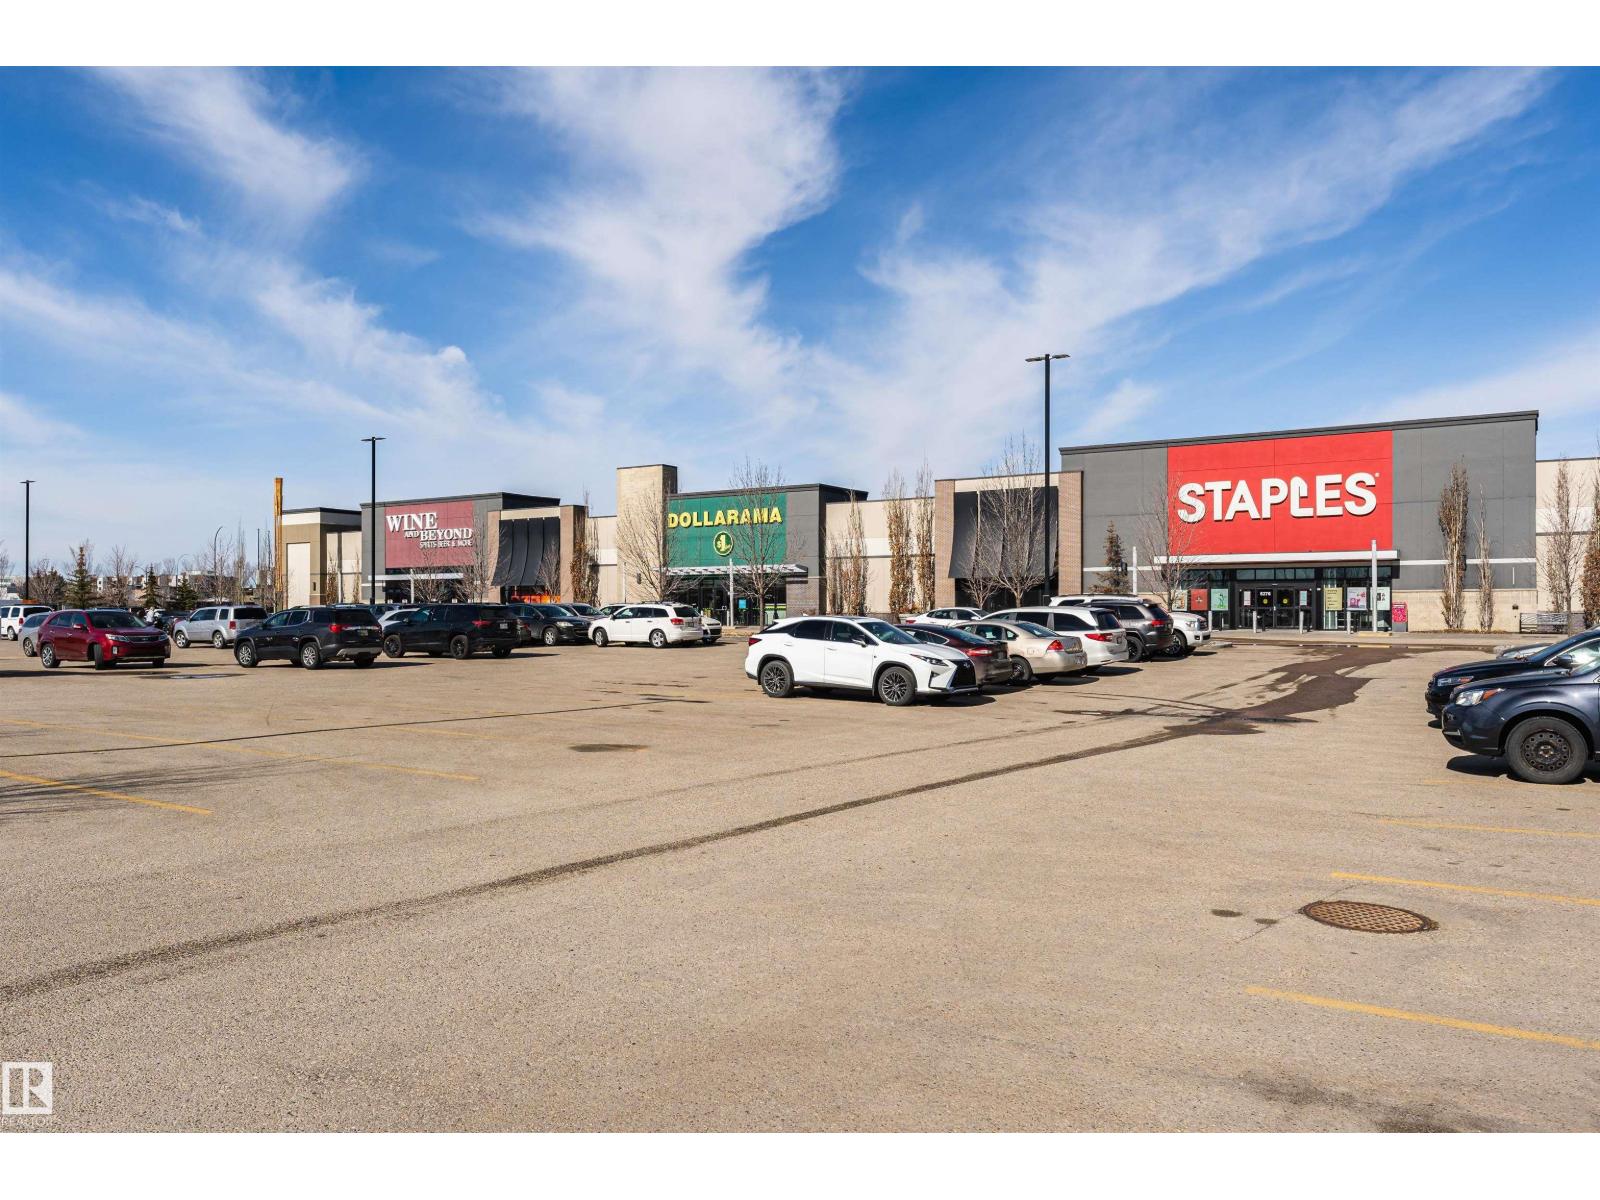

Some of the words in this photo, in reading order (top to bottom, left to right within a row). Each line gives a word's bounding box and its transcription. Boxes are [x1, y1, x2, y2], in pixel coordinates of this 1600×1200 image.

[1177, 472, 1377, 524] STAPLES
[386, 512, 438, 532] WINE
[667, 507, 783, 529] DOLLARAMA
[404, 530, 420, 538] AND
[420, 528, 473, 541] BEYOND
